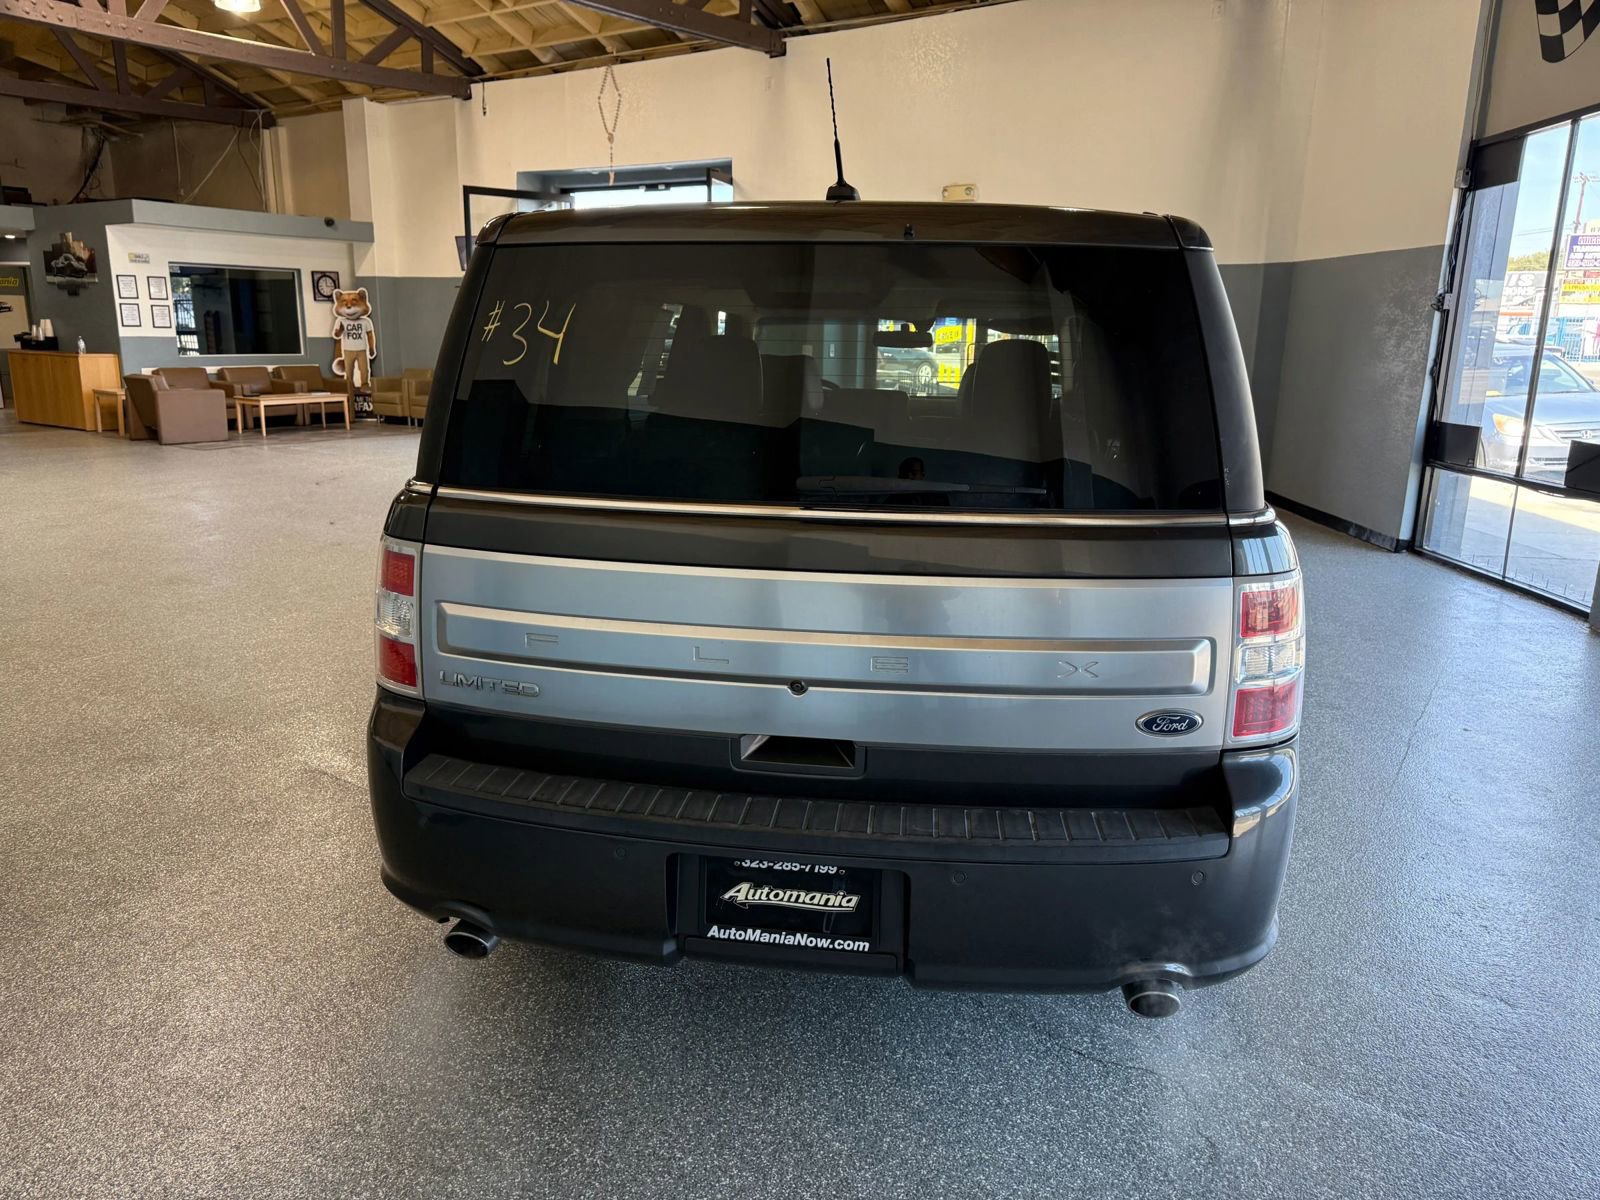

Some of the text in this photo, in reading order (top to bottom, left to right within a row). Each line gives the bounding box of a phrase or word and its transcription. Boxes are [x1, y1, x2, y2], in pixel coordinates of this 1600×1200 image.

[346, 323, 362, 332] CAR
[346, 332, 362, 340] FOX
[481, 299, 577, 366] #34
[439, 670, 541, 698] LIMITED
[1152, 715, 1190, 731] Ford
[721, 881, 860, 912] Automania
[707, 925, 870, 951] AutoManiaNow.com
